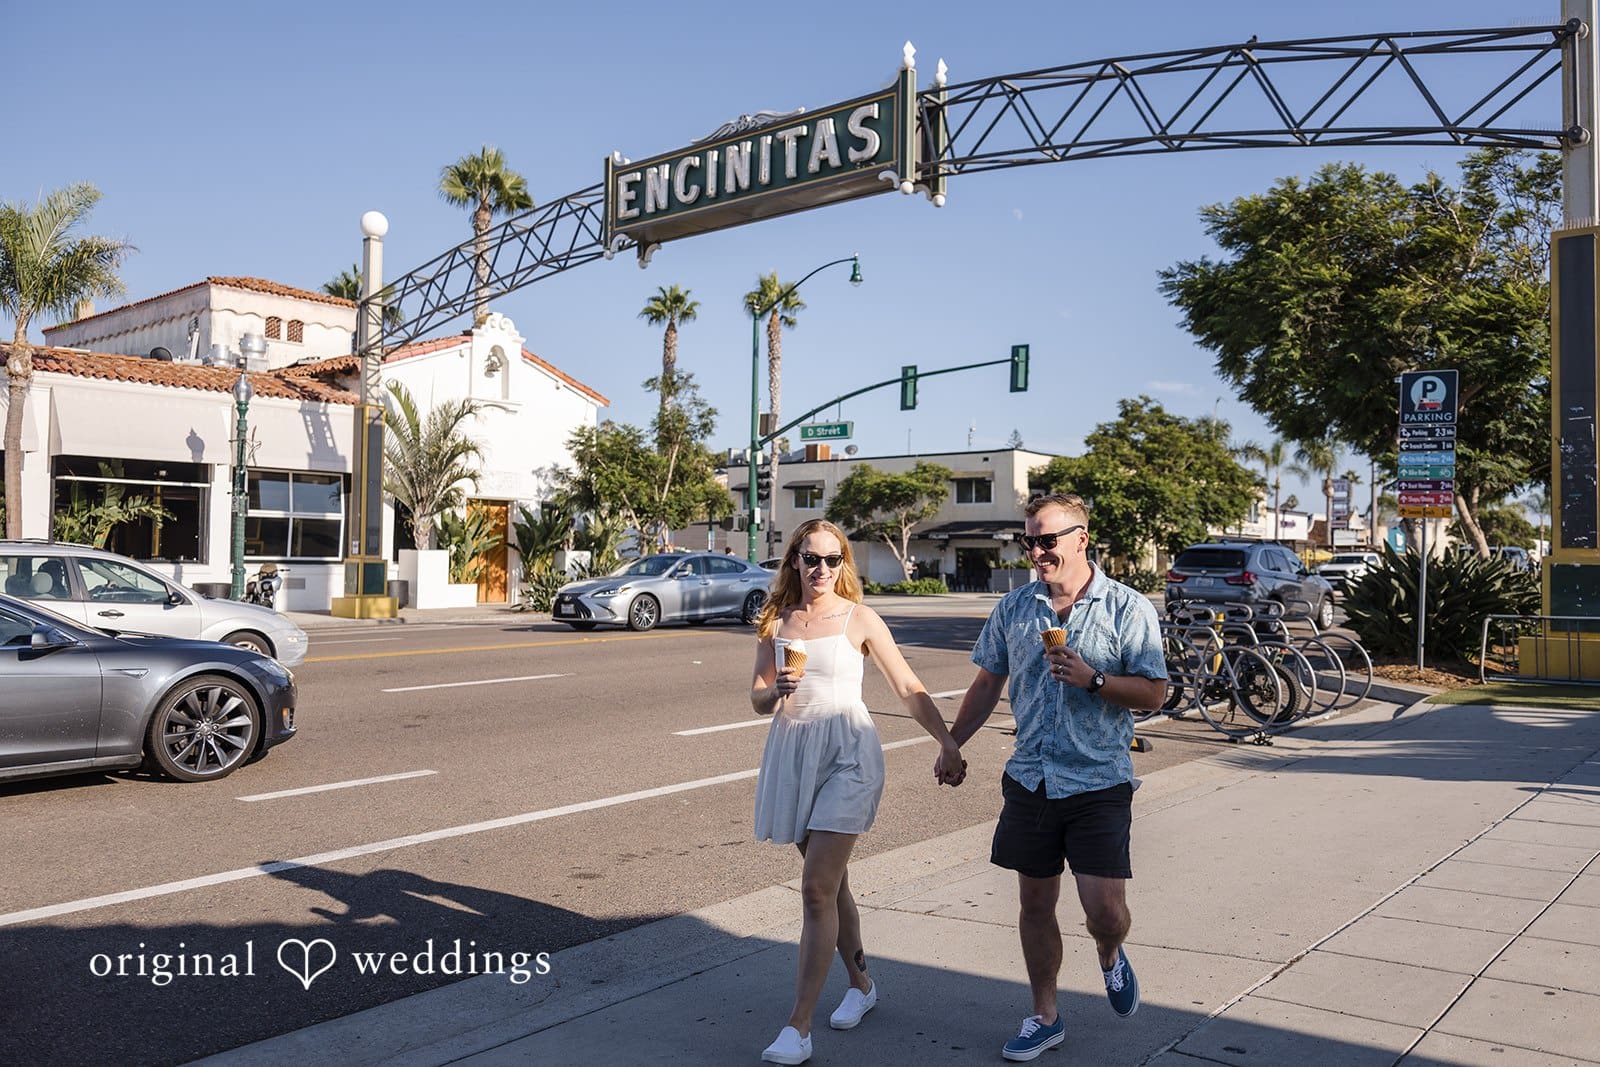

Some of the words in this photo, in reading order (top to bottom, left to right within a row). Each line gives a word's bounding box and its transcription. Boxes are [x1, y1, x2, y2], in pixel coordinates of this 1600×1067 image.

[617, 102, 880, 220] ENCINITAS
[1422, 380, 1437, 399] P
[1404, 412, 1453, 422] PARKING
[808, 428, 814, 436] D
[816, 426, 841, 436] Street
[1411, 429, 1428, 437] Parking
[1435, 428, 1446, 437] 2-3
[1440, 481, 1445, 490] 2
[1439, 494, 1444, 503] 2
